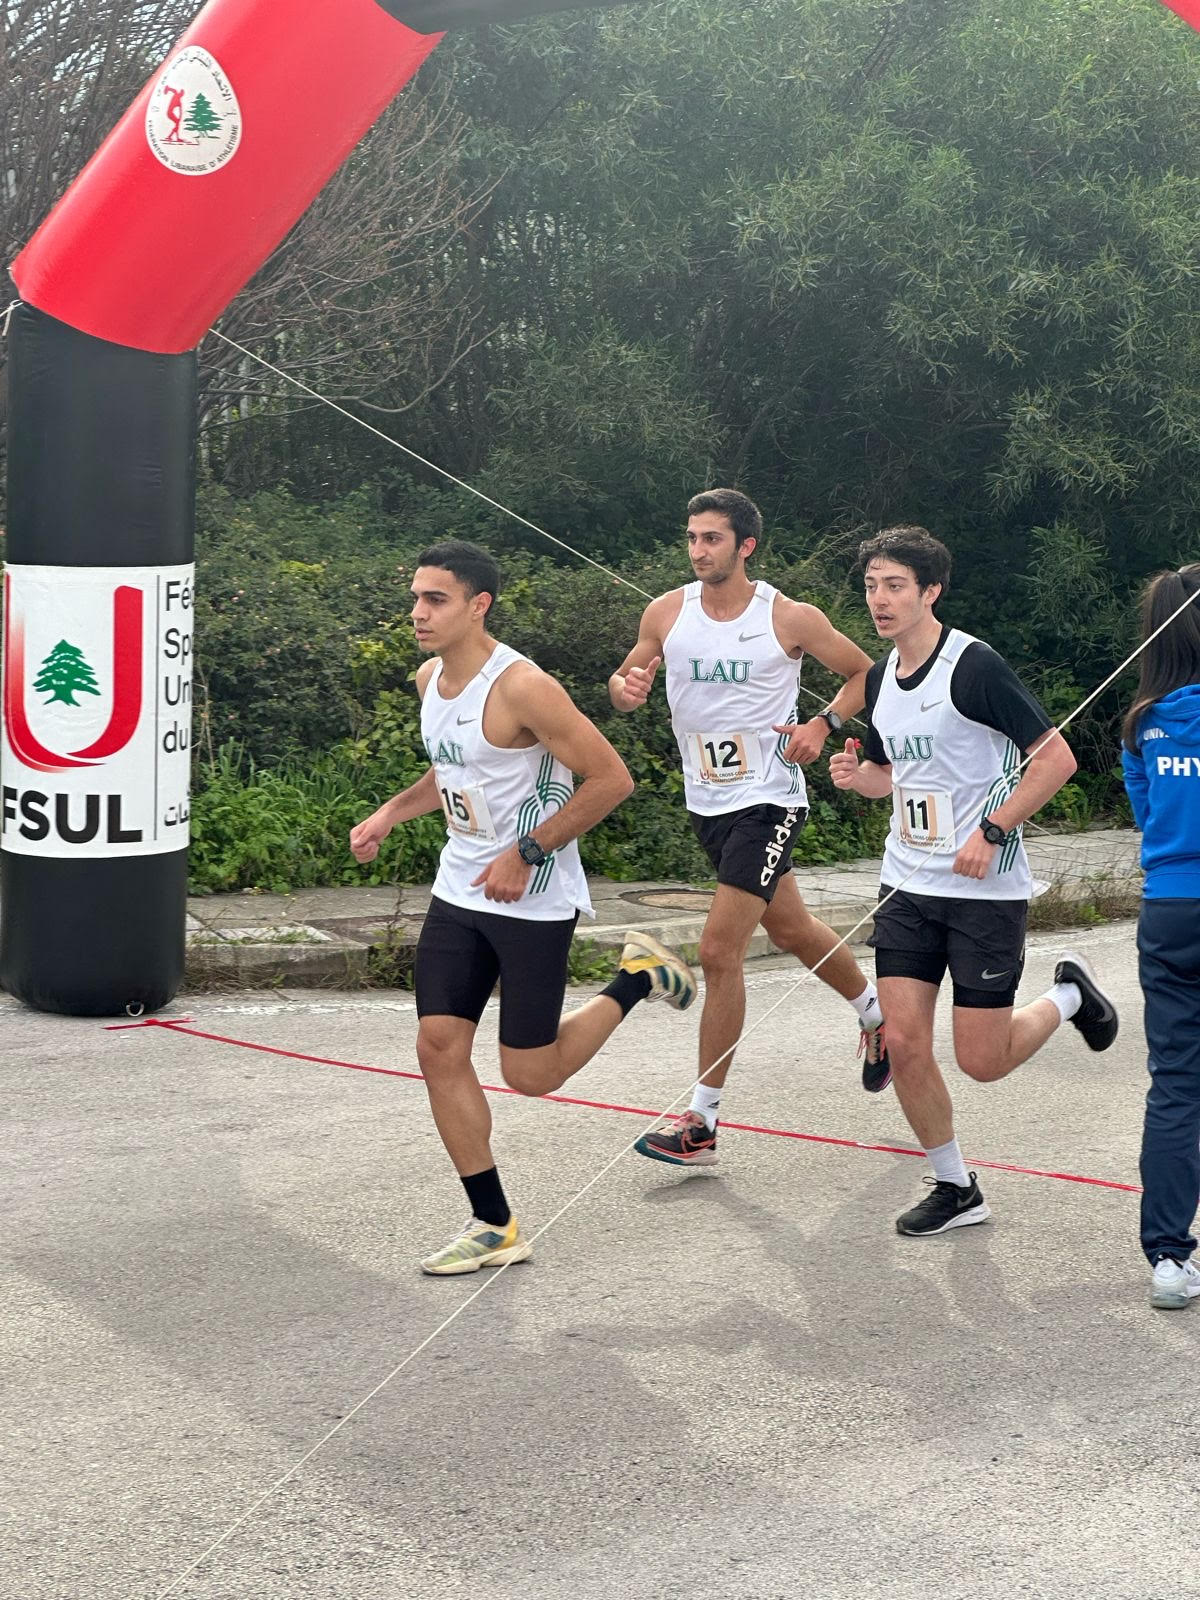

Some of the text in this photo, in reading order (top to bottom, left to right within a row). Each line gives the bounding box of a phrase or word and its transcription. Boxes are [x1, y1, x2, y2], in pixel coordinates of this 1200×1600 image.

[688, 658, 753, 685] LAU
[163, 720, 189, 754] du
[426, 736, 466, 768] LAU
[885, 734, 934, 762] LAU
[704, 740, 742, 768] 12
[3, 785, 143, 844] FSUL
[441, 787, 470, 821] 15
[906, 798, 929, 831] 11
